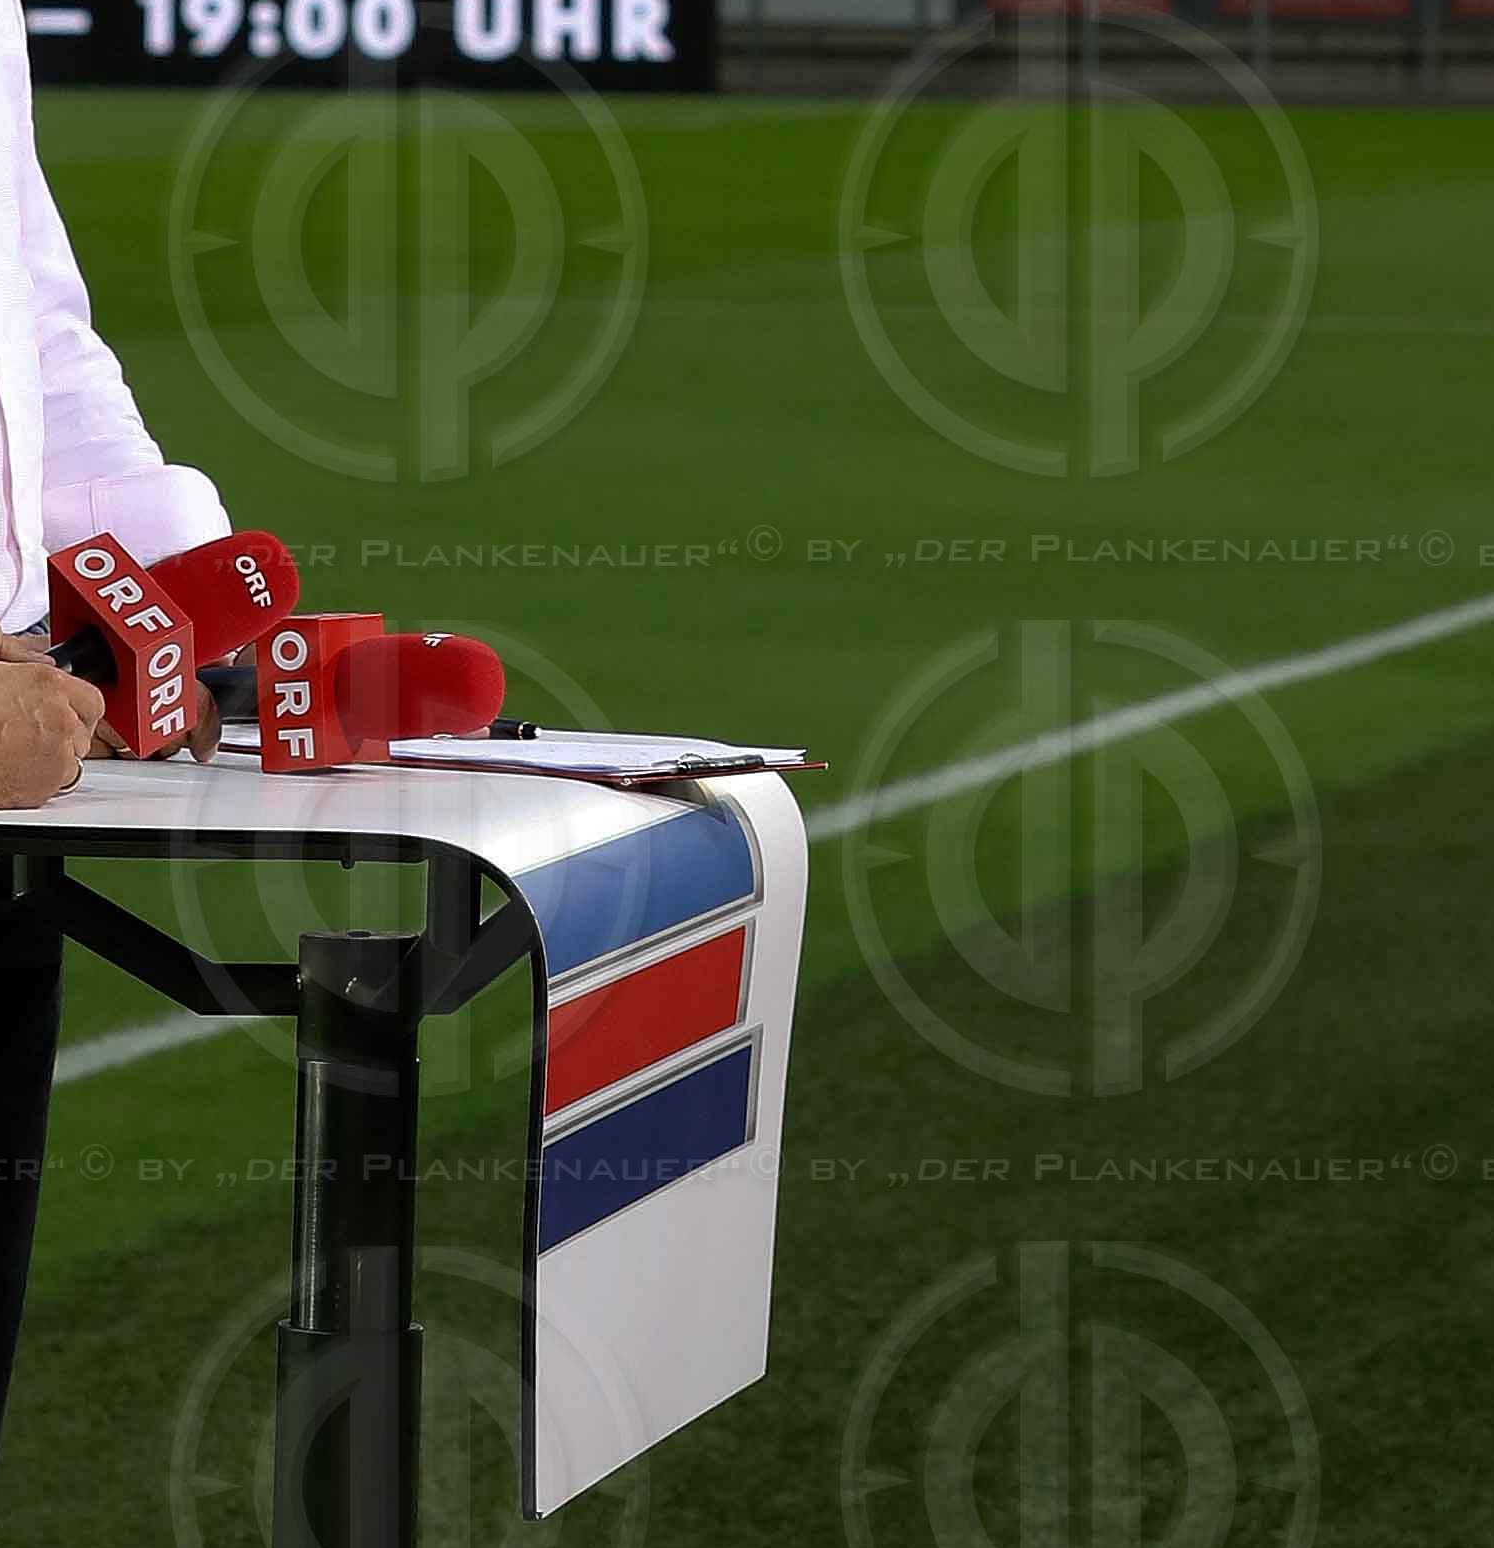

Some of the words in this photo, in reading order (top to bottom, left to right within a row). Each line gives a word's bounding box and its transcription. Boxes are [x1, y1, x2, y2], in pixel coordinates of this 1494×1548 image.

[74, 547, 174, 634] ORF
[234, 555, 274, 610] ORF
[147, 642, 185, 738] ORF
[271, 629, 315, 762] ORF
